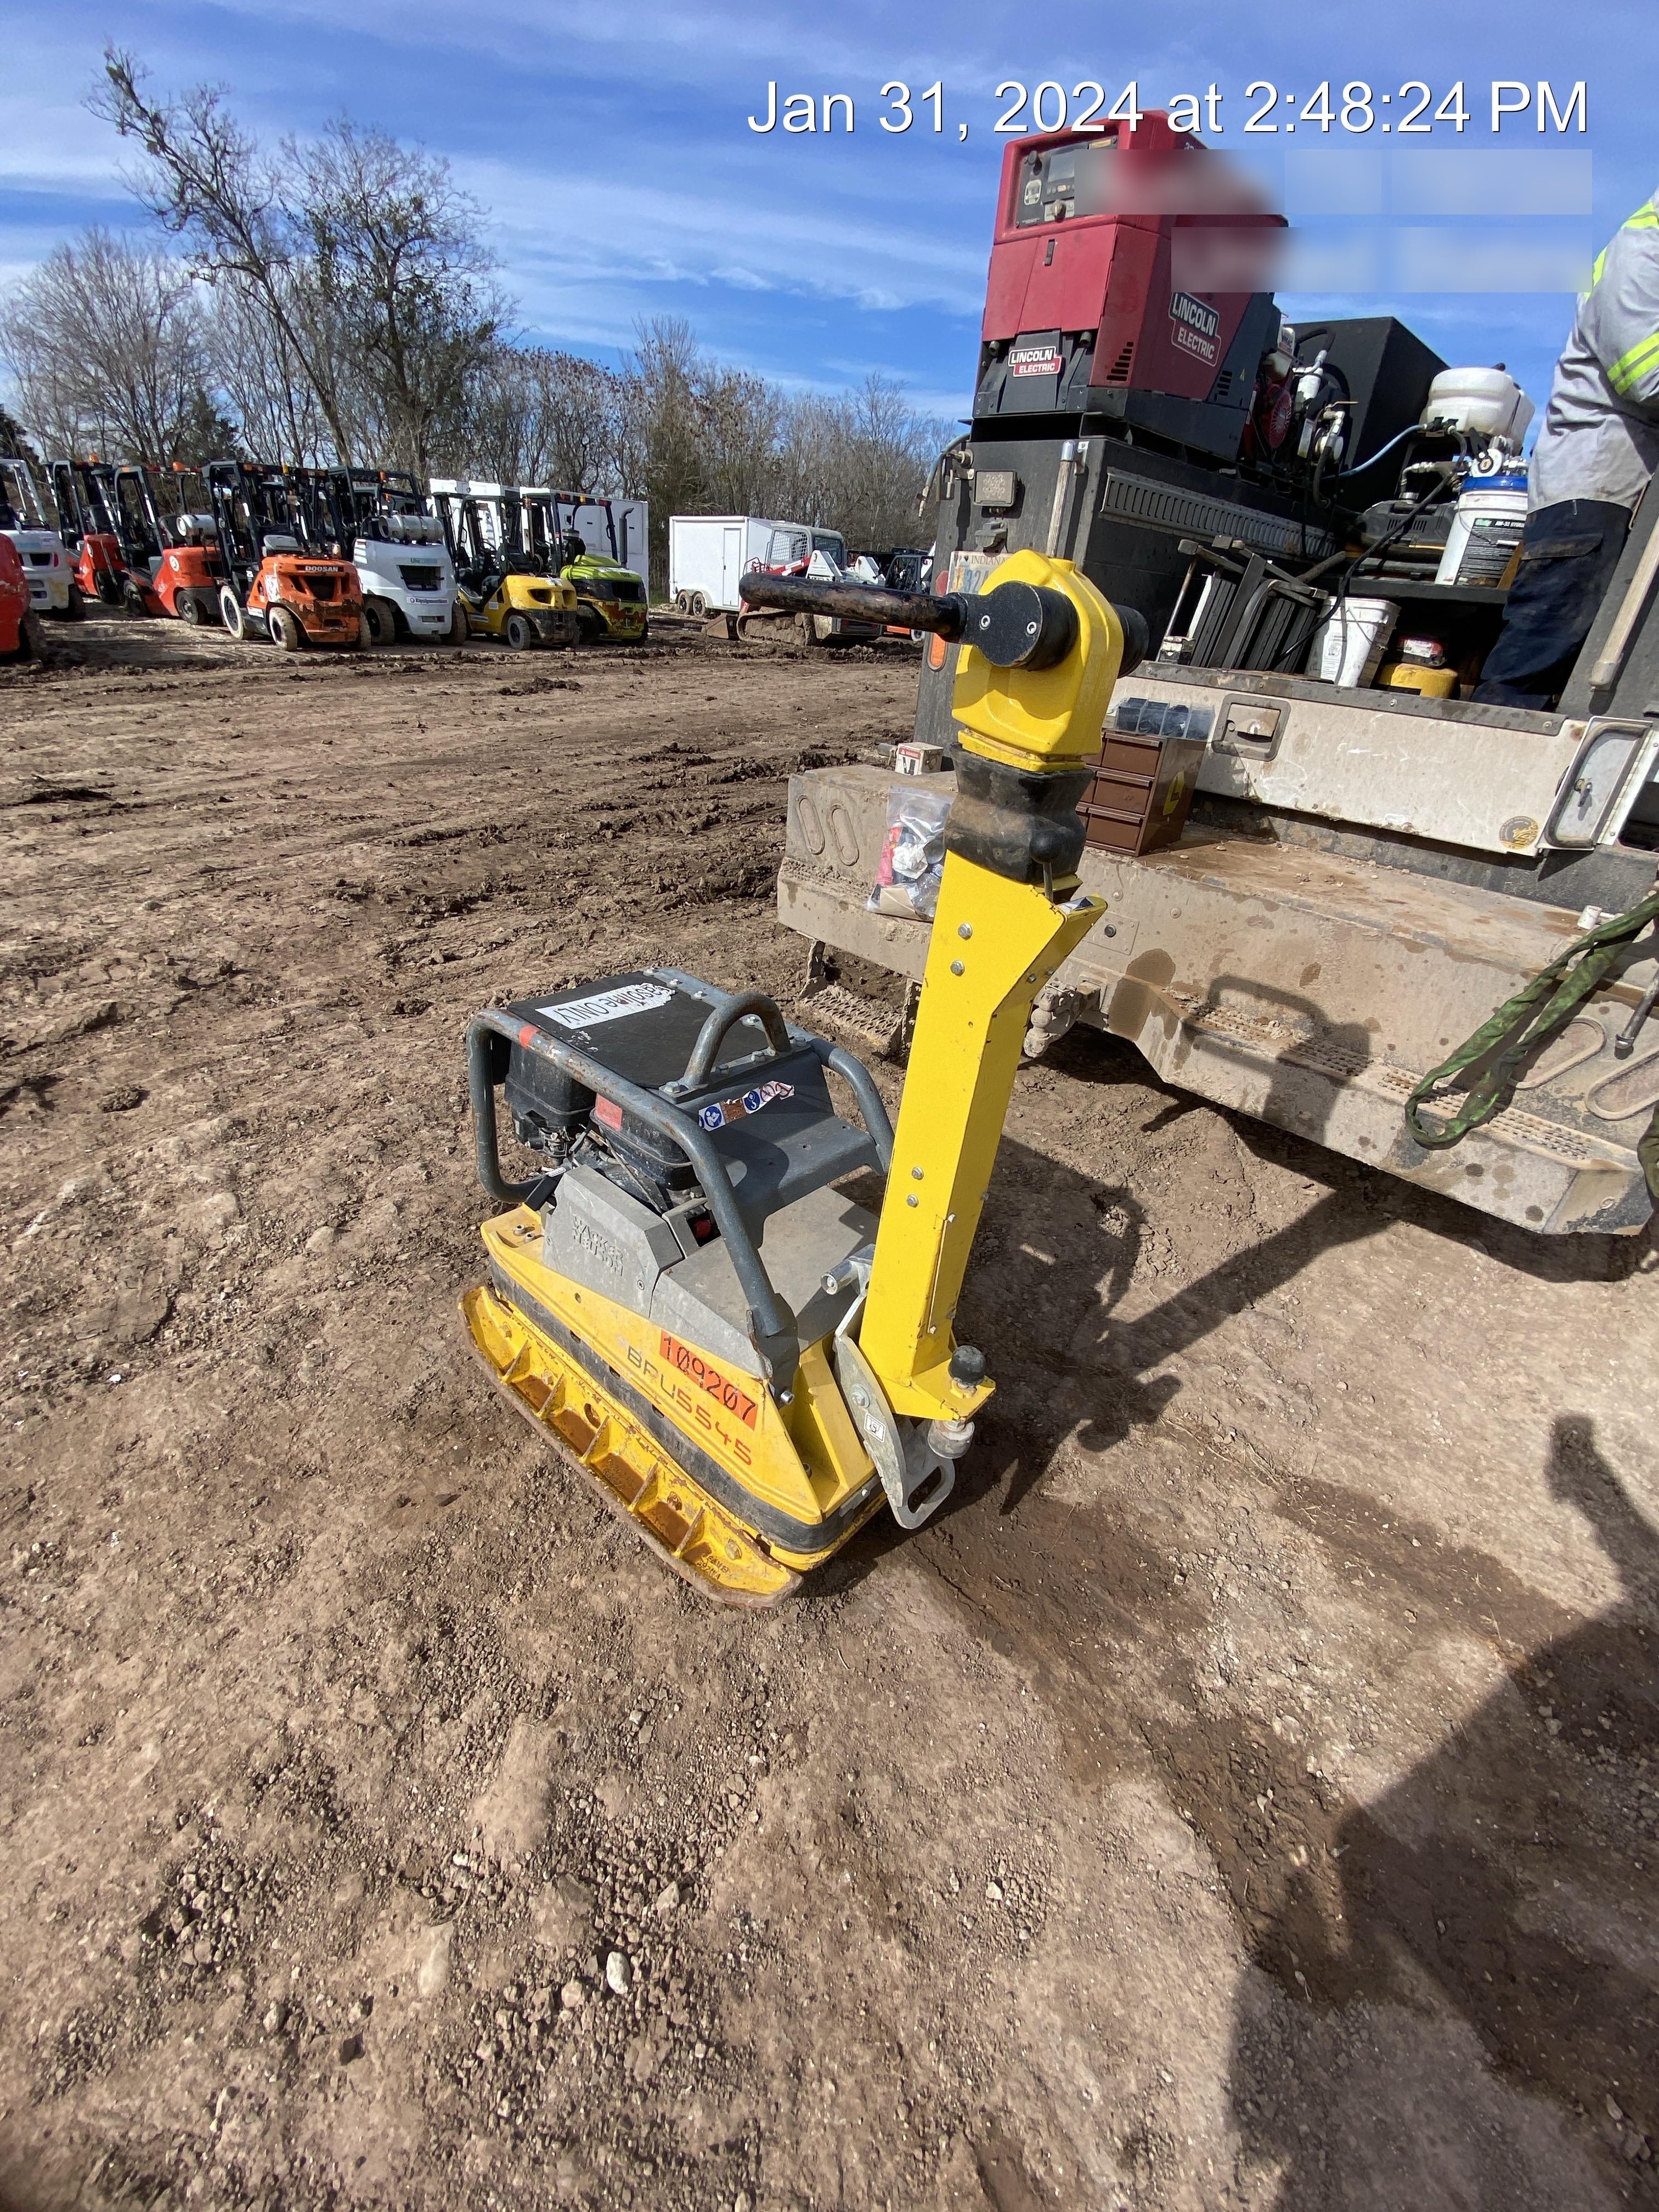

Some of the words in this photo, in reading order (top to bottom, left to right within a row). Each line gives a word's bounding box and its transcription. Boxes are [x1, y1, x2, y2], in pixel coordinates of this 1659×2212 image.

[1172, 292, 1216, 337] LINCOLN
[1011, 349, 1053, 364] LINCOLN
[1177, 326, 1215, 359] ELECTRIC
[1019, 363, 1056, 374] ELECTRIC
[553, 1002, 610, 1024] ONLY
[572, 1214, 624, 1265] WACKER
[573, 1227, 624, 1277] NEUSON
[663, 1335, 756, 1421] 109207
